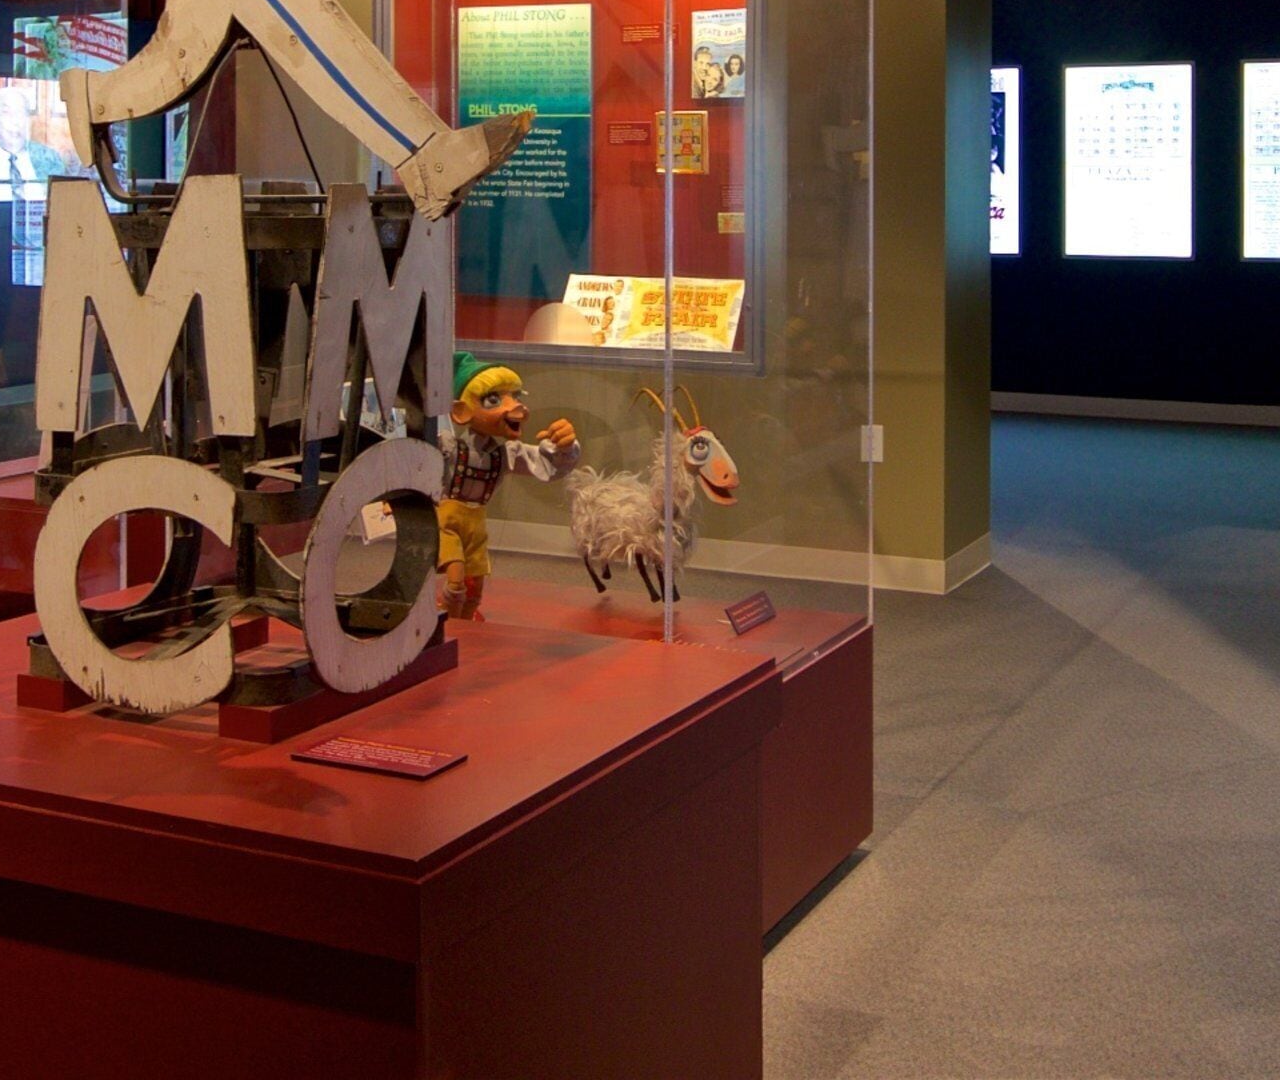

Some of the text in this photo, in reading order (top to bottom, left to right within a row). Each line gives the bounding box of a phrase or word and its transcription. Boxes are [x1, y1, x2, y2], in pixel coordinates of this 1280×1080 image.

[493, 10, 520, 22] PHIL
[522, 8, 566, 22] STONG
[468, 104, 538, 115] PHIL STONG
[515, 169, 550, 177] Encouraged
[534, 180, 564, 189] beginning
[36, 174, 255, 437] M
[302, 182, 455, 442] M
[34, 454, 236, 714] C
